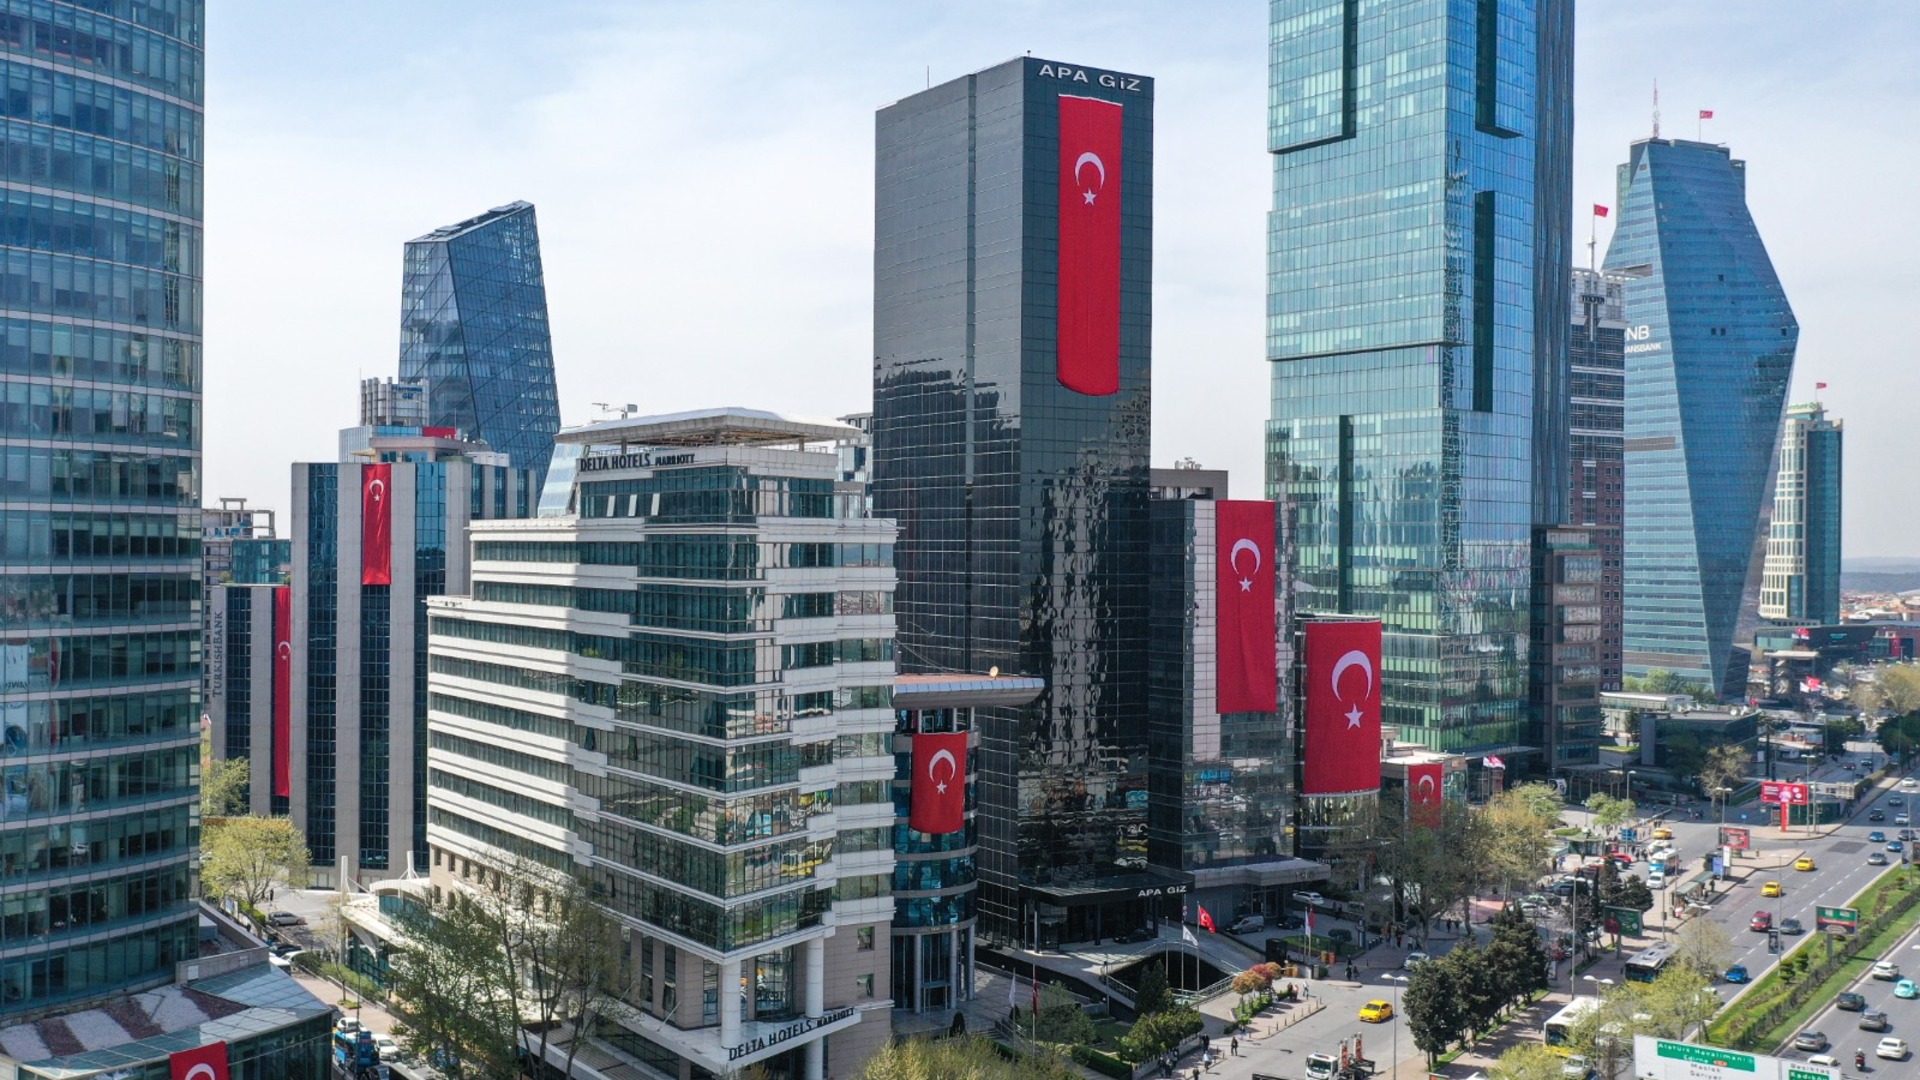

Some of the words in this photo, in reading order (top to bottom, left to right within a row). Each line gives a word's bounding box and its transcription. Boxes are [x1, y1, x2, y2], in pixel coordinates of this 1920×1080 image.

[1039, 64, 1088, 83] APA
[1624, 324, 1650, 341] NB
[1624, 342, 1662, 353] ANSBANK
[580, 457, 609, 472] DELTA
[611, 453, 651, 469] HOTELS
[655, 453, 695, 466] MARRIOTT
[1138, 888, 1162, 897] APA
[729, 1037, 765, 1061] DELTA
[768, 1019, 812, 1046] HOTELS
[817, 1007, 855, 1028] MARRIOTT
